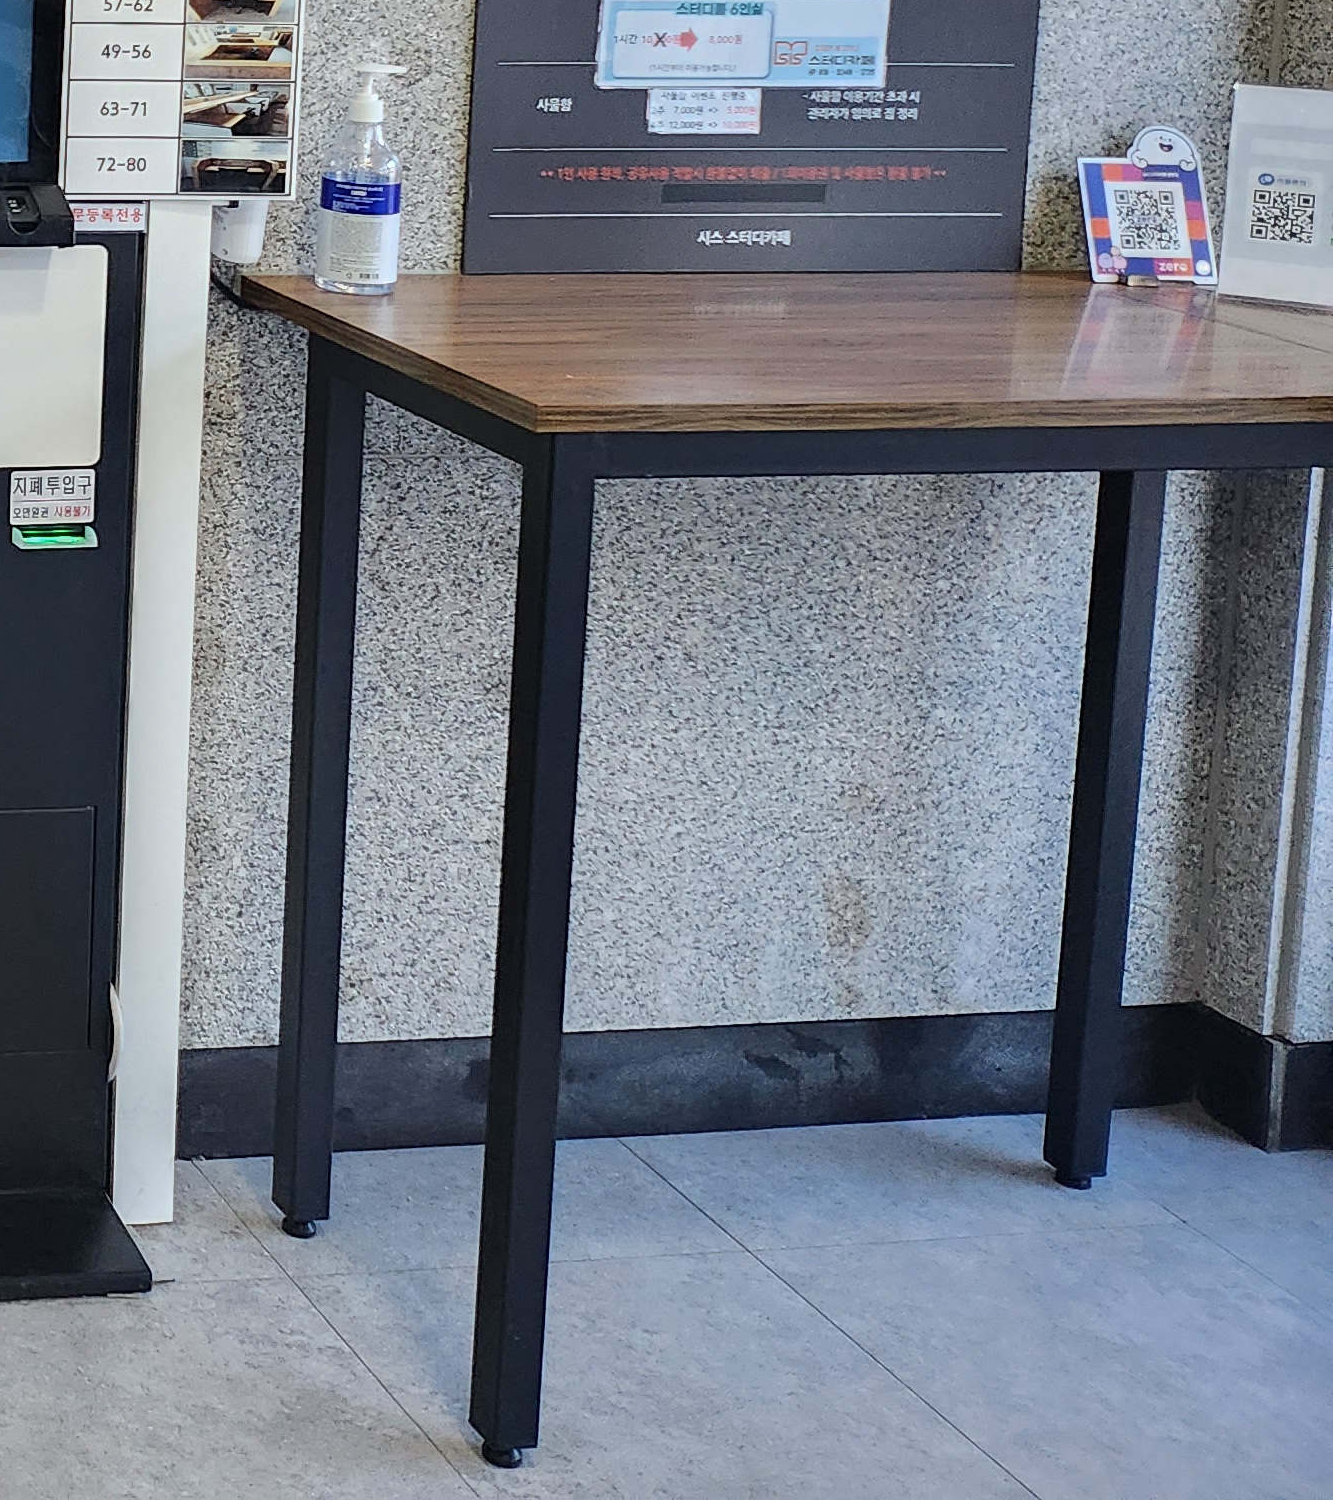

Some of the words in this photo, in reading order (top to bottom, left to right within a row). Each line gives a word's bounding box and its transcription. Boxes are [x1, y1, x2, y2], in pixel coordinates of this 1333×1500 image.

[100, 45, 152, 60] 49-56
[100, 102, 147, 117] 63-71
[536, 98, 573, 114] 사물함
[96, 157, 147, 172] 72-80
[696, 229, 723, 246] 시스
[726, 229, 792, 247] 스터디카페
[1158, 260, 1187, 271] zero
[12, 475, 92, 496] 지폐투입구
[54, 506, 90, 518] 사용불가
